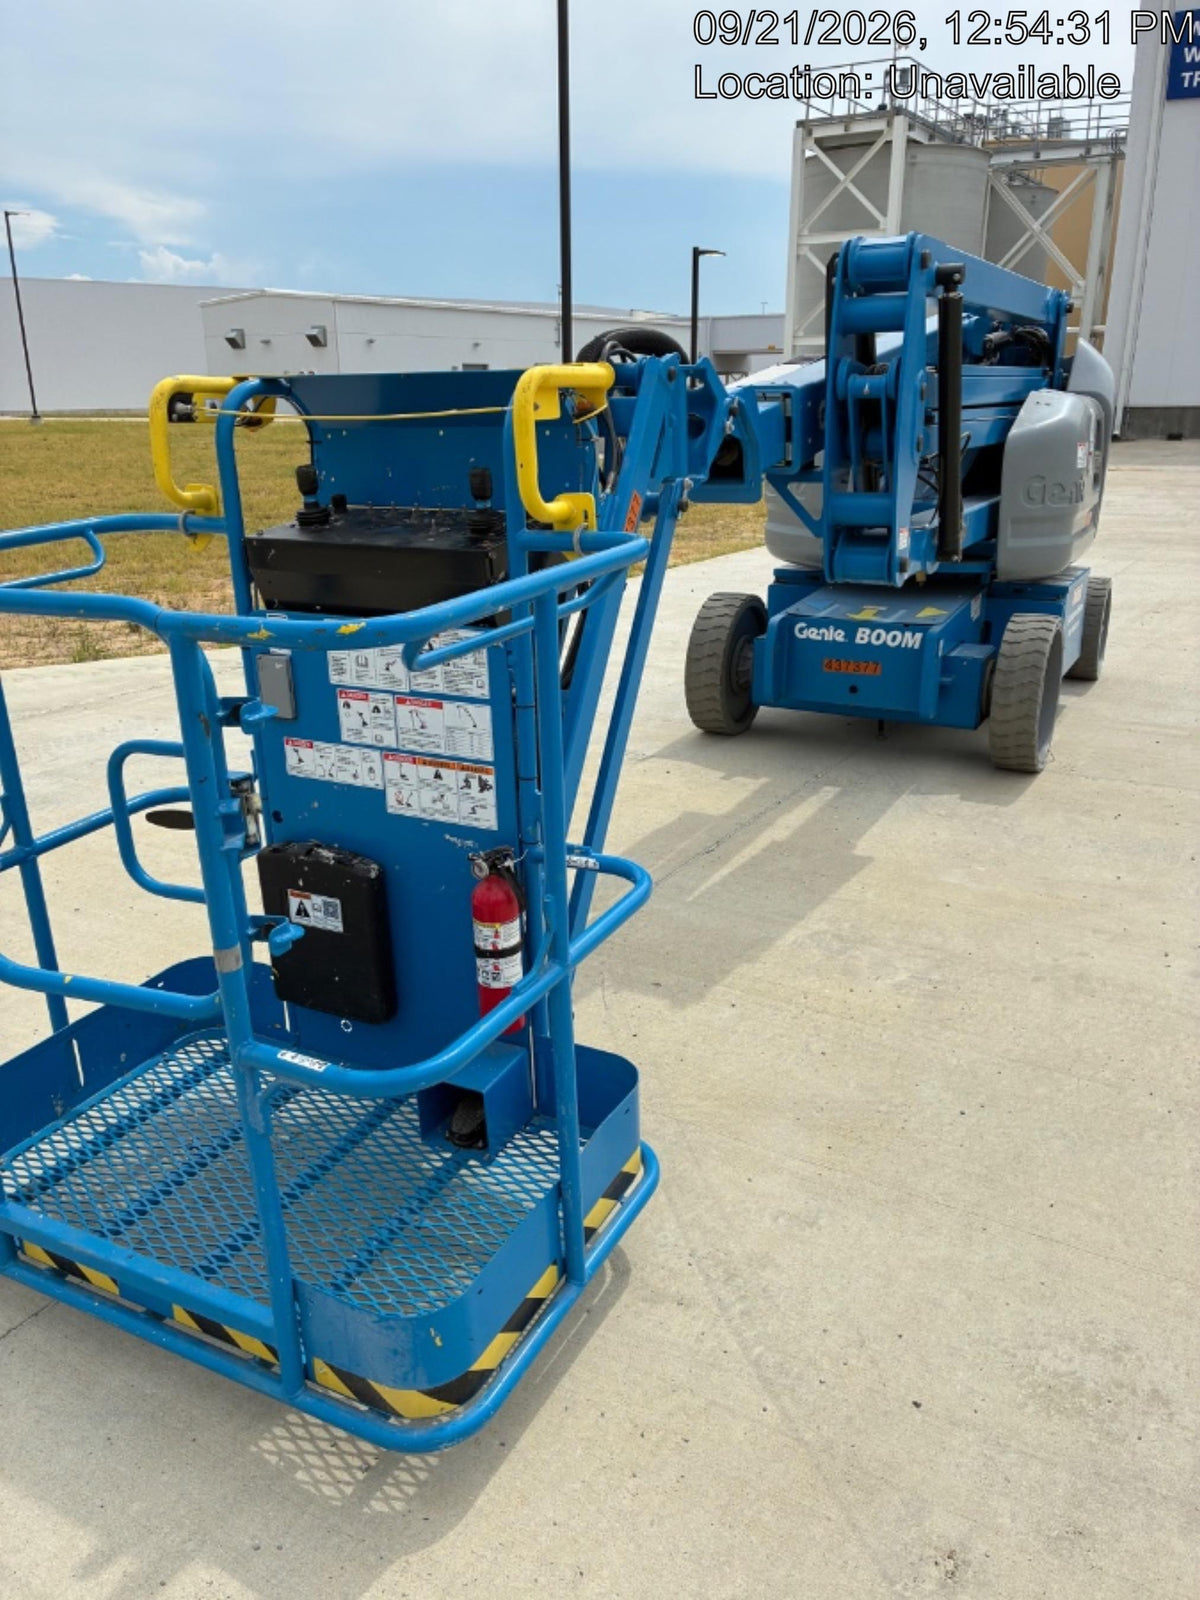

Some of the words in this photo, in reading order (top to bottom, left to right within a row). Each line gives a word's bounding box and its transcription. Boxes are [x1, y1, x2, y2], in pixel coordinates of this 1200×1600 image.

[794, 621, 846, 643] Genie
[855, 626, 923, 650] BOOM
[824, 658, 881, 675] 437377
